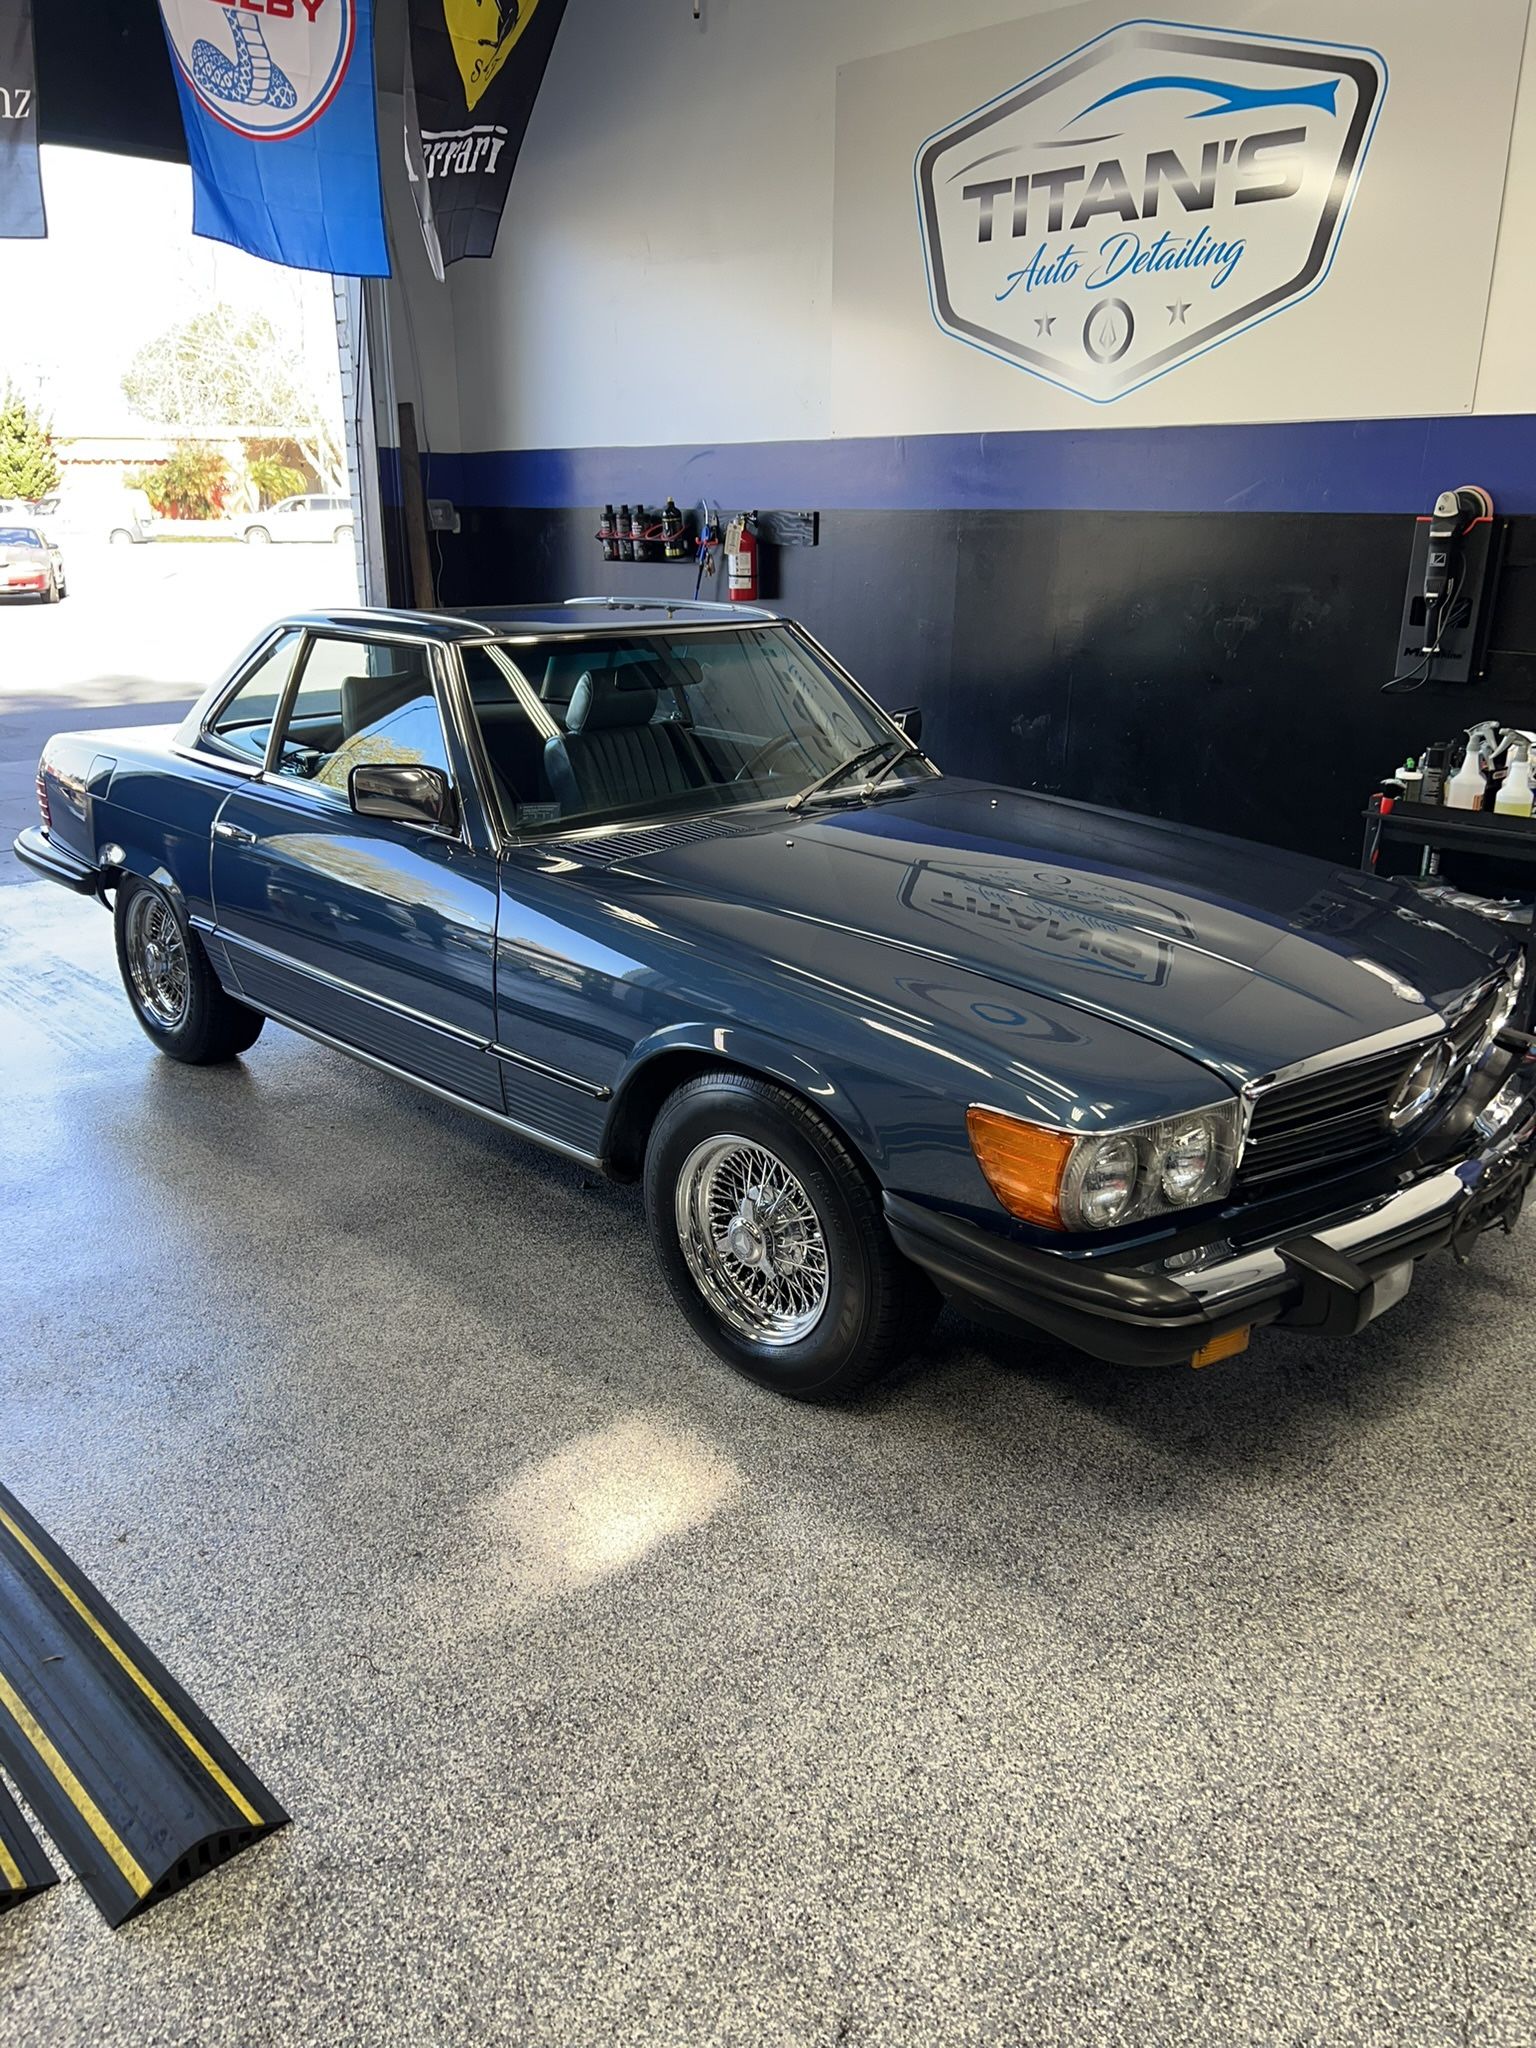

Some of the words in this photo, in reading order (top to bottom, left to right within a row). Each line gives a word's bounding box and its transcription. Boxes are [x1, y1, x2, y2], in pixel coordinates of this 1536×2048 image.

[963, 126, 1307, 243] TITAN'S
[995, 242, 1088, 302] Auto
[1085, 225, 1248, 290] Detailing
